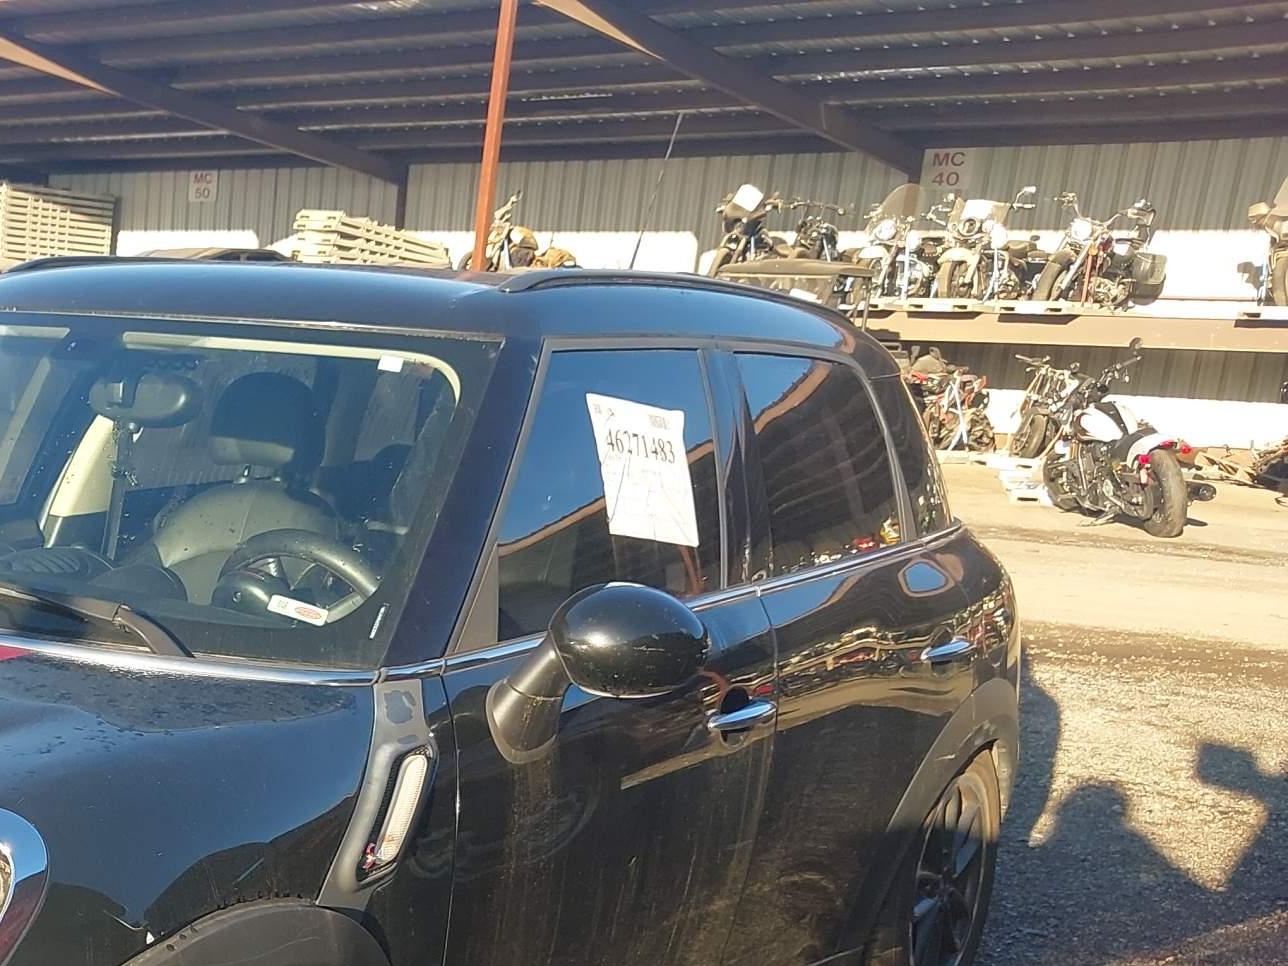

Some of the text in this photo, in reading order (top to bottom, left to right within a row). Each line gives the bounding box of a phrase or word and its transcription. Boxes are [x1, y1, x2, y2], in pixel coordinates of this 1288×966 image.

[932, 151, 965, 167] MC
[193, 172, 213, 185] MC
[932, 171, 960, 187] 40
[606, 428, 676, 464] 46271483
